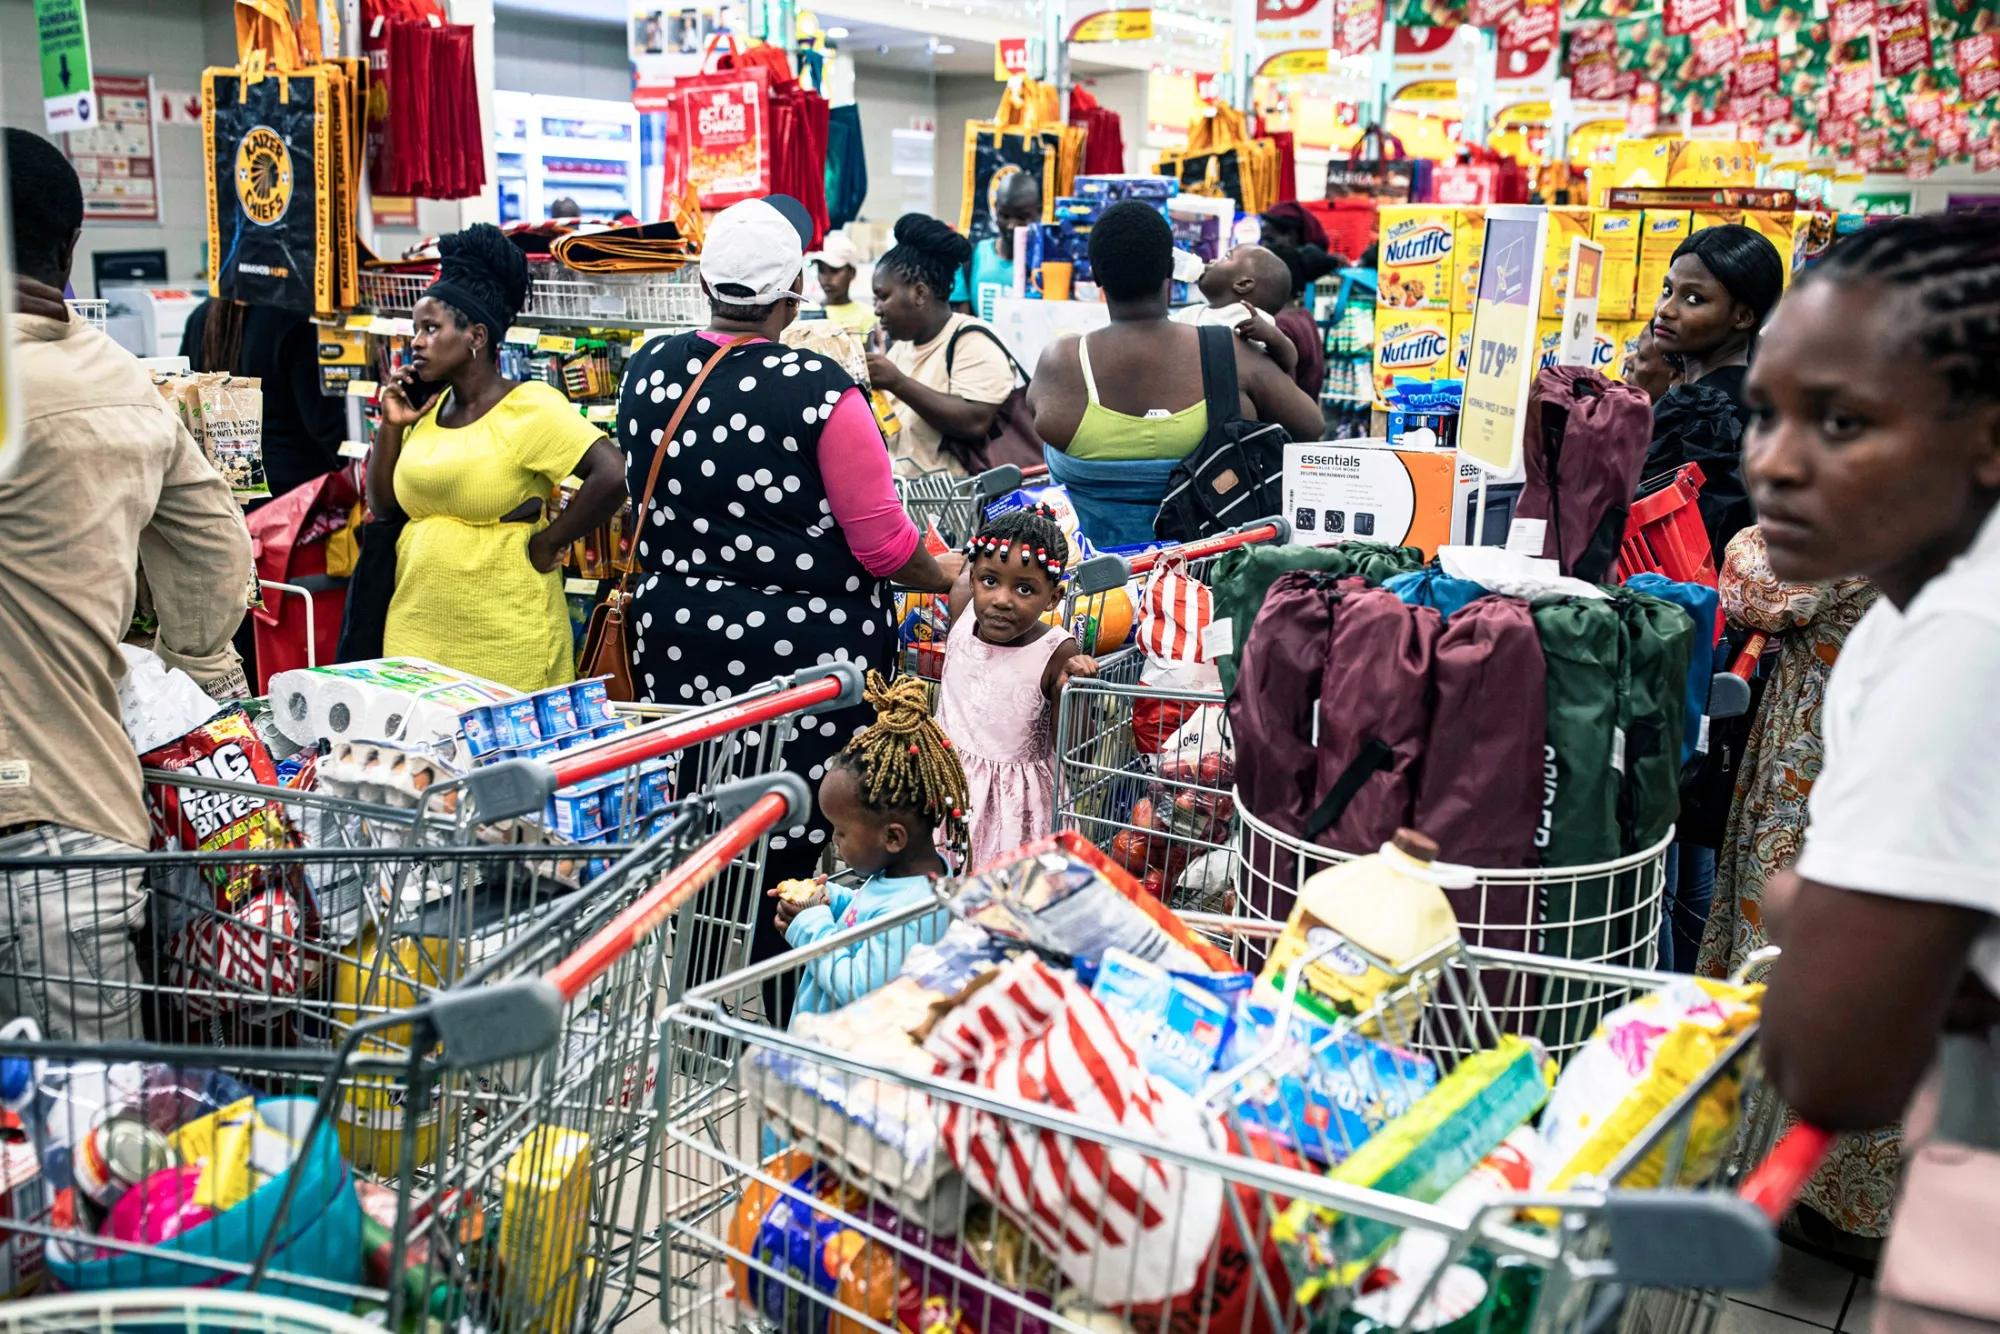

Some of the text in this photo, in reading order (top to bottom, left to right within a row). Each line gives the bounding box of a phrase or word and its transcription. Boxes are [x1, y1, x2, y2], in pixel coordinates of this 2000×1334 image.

[1005, 48, 1026, 69] 11
[244, 131, 284, 162] KAIZER
[317, 142, 326, 191] KAIZER
[244, 190, 285, 219] CHIEFS
[317, 198, 326, 250] CHIEFS
[1385, 231, 1452, 263] Nutrific
[316, 250, 326, 297] KAIZER
[341, 238, 350, 290] KAIZER
[1573, 311, 1582, 340] 6
[1380, 334, 1447, 364] Nutrific
[1478, 339, 1506, 378] 179
[1408, 393, 1462, 407] MANHAT
[1301, 454, 1360, 467] essentials
[178, 743, 249, 803] BIG
[191, 794, 266, 840] BITES
